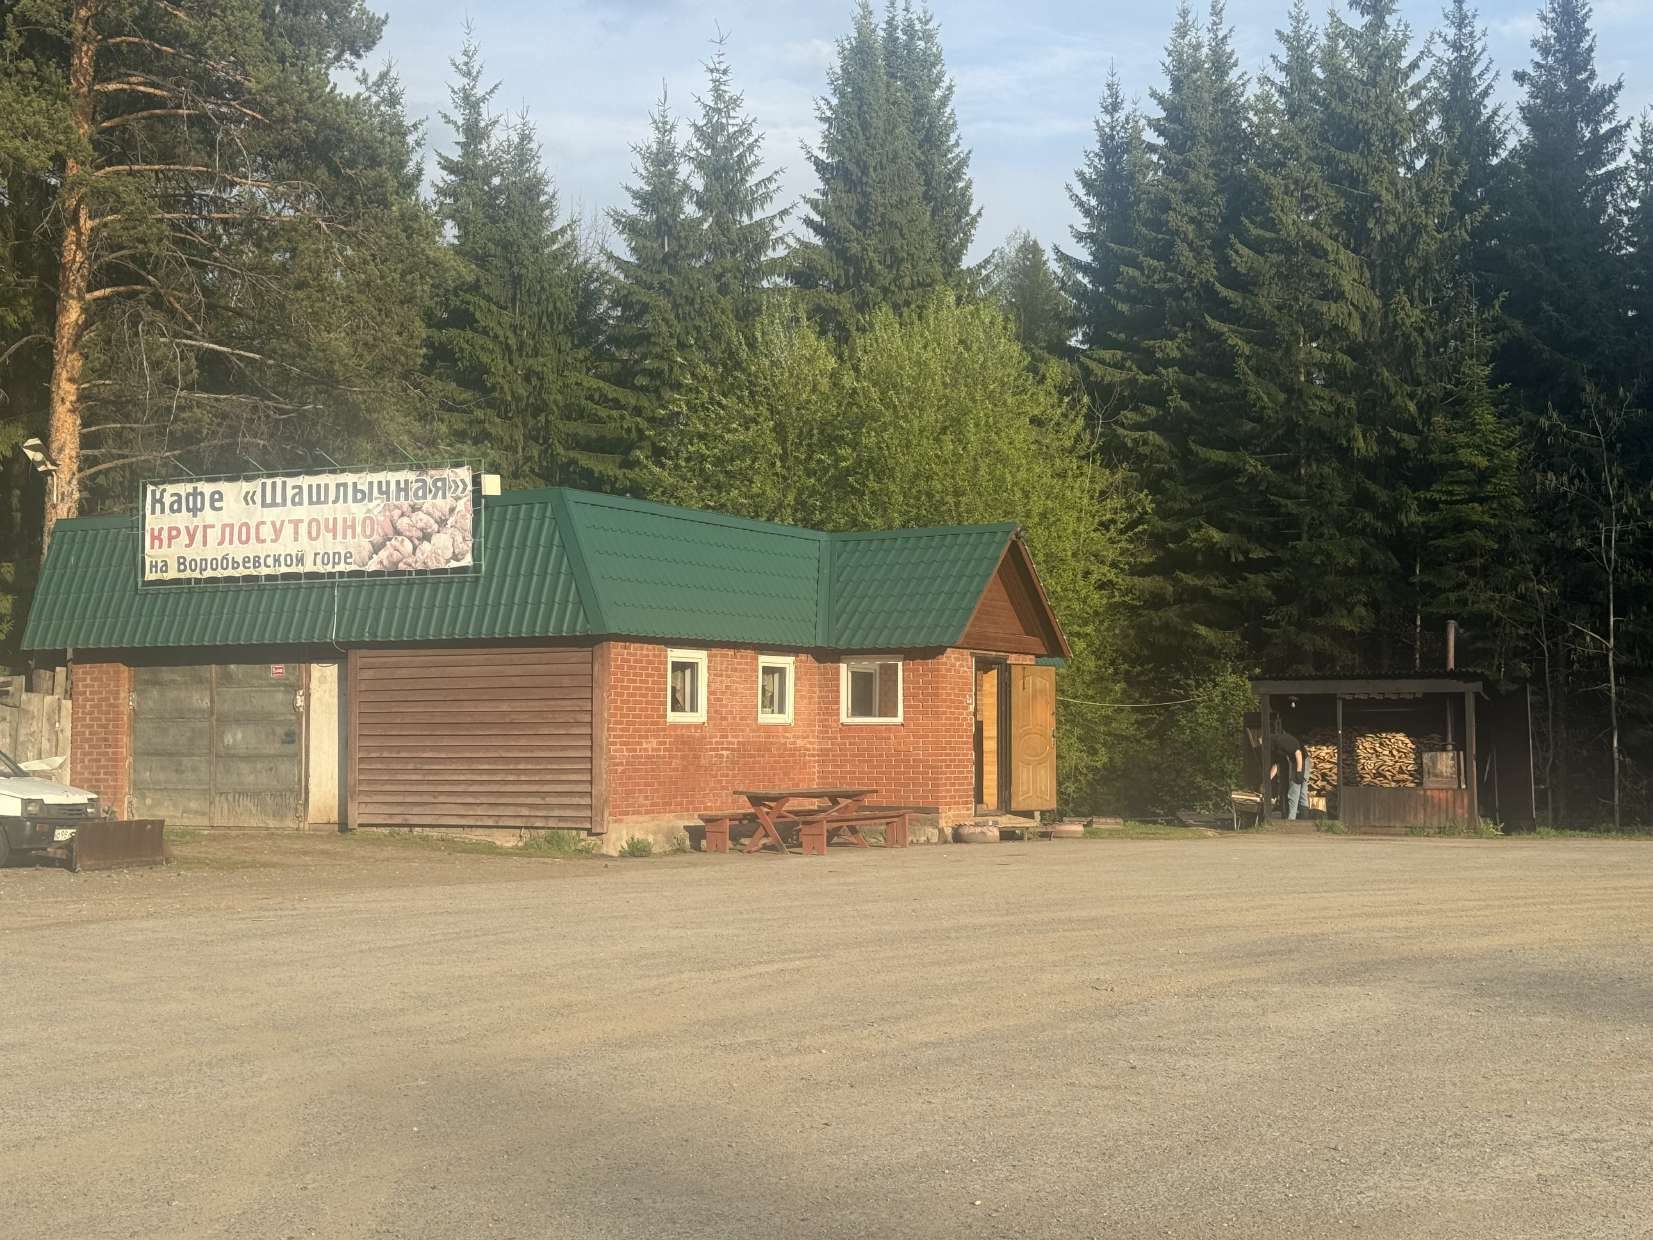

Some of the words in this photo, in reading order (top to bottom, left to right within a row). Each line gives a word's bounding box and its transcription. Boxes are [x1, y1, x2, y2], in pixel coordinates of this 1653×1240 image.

[150, 486, 224, 518] Кафе
[242, 477, 468, 508] «Шашлычная»
[150, 516, 379, 550] КРУГЛОСУТОЧНО
[149, 559, 169, 575] на
[177, 550, 305, 575] Воробьевской
[313, 552, 354, 571] горе
